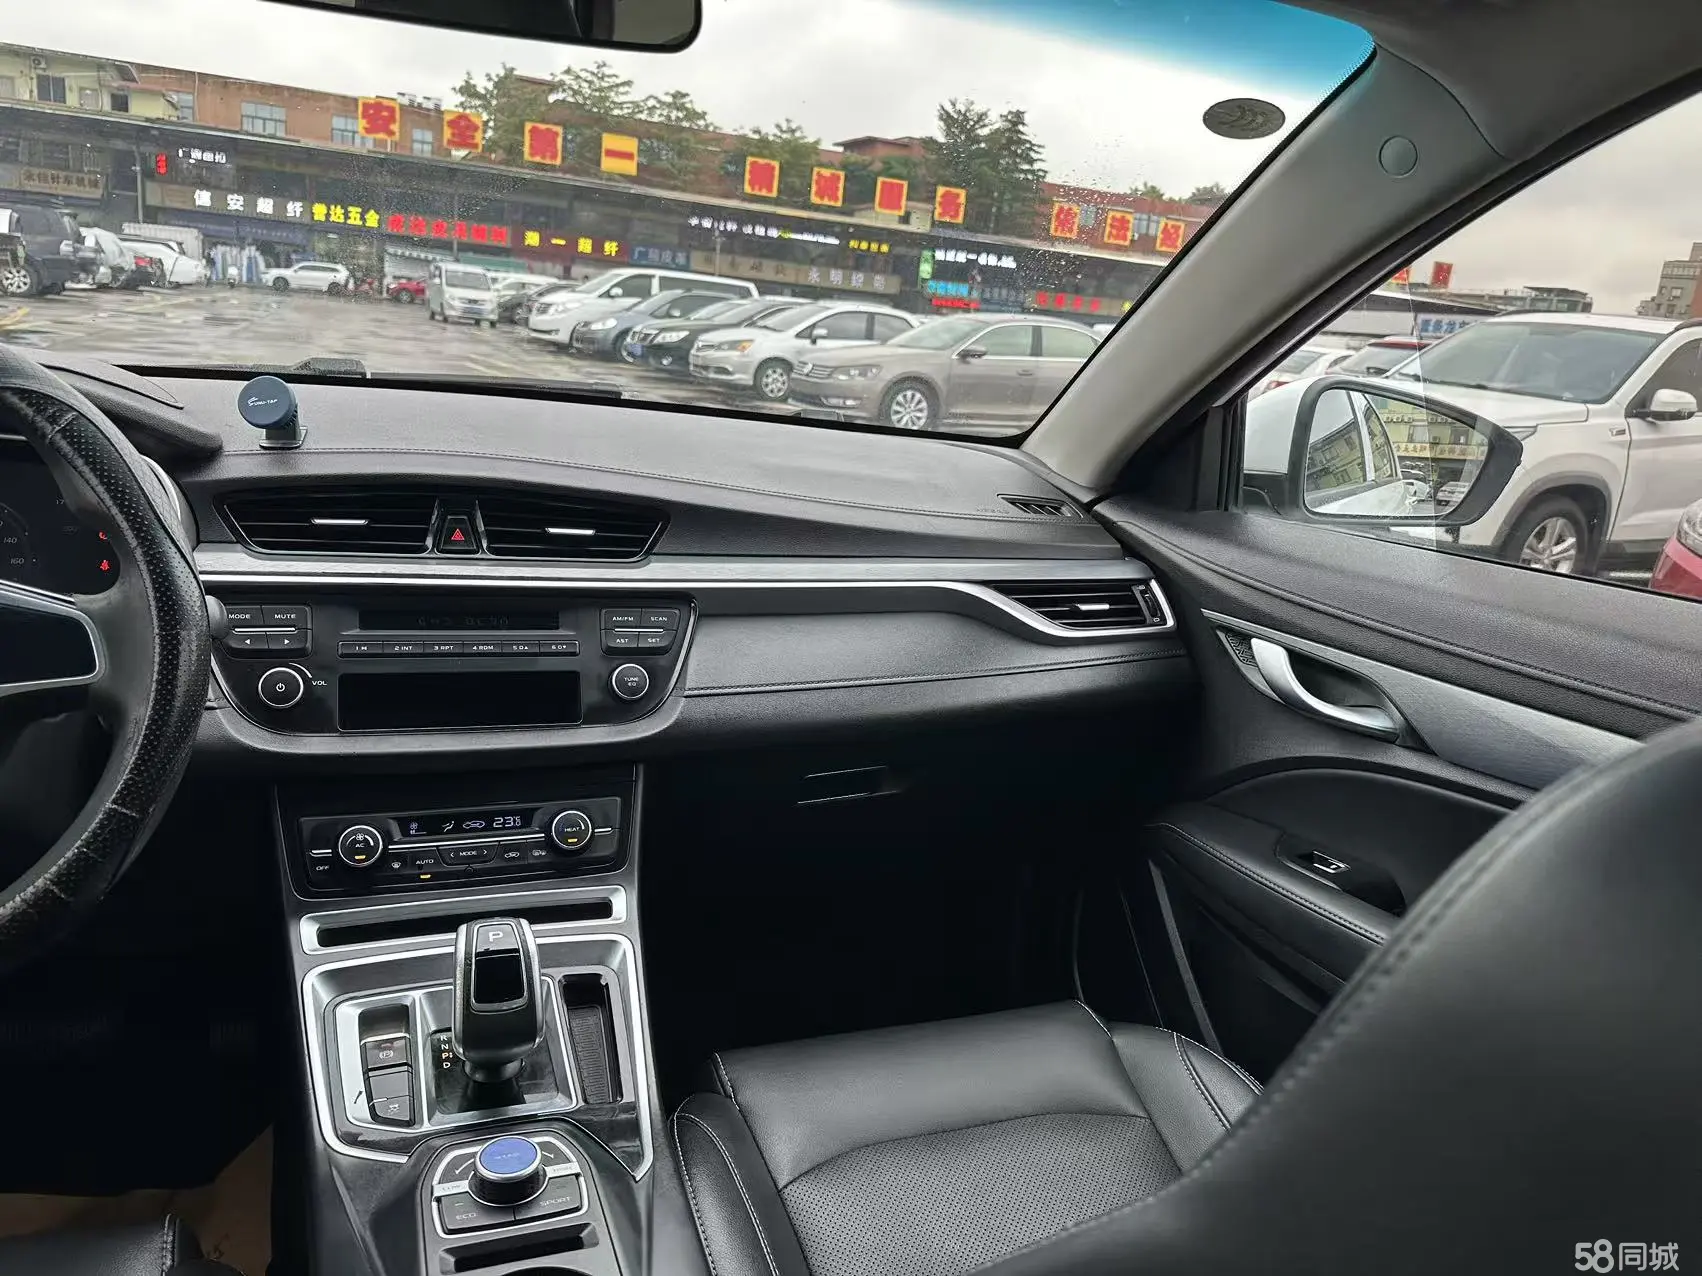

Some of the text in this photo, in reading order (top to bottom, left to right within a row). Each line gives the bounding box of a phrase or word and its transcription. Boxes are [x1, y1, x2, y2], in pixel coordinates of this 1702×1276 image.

[488, 931, 504, 943] P
[442, 1061, 451, 1069] D
[540, 1195, 573, 1207] SPORT
[455, 1211, 477, 1221] ECO
